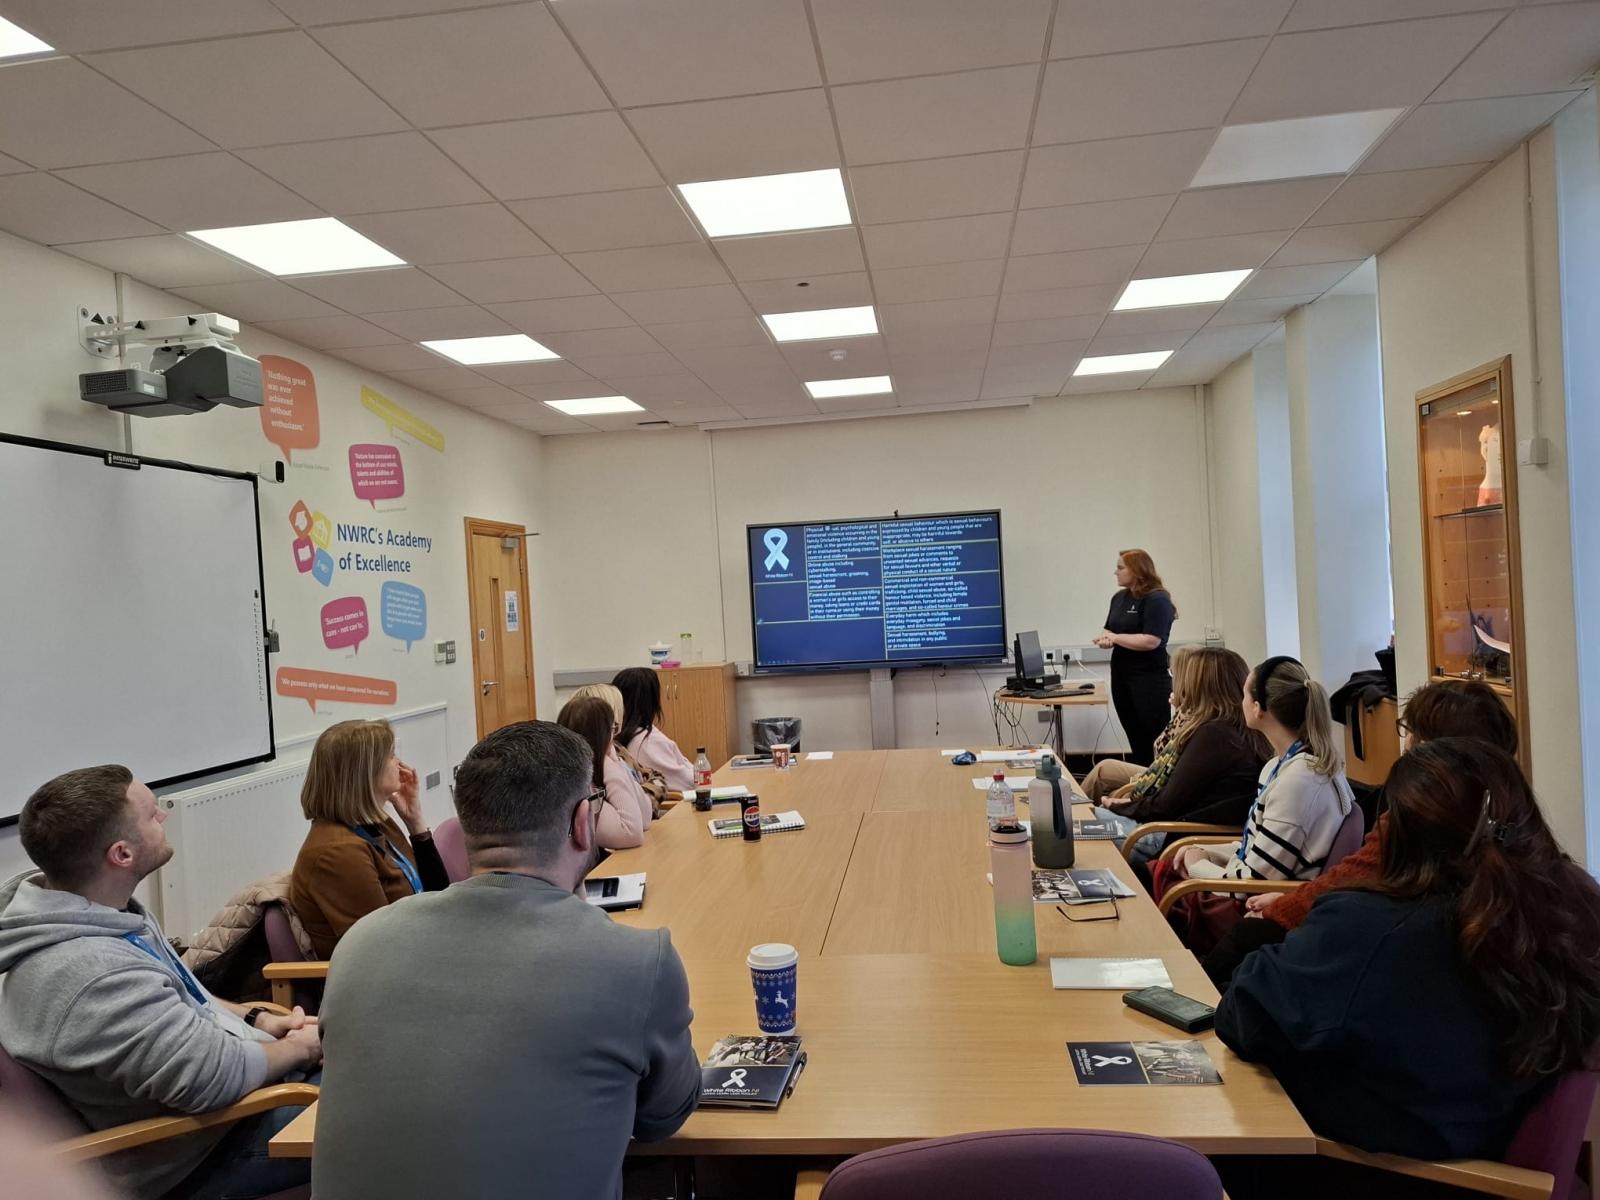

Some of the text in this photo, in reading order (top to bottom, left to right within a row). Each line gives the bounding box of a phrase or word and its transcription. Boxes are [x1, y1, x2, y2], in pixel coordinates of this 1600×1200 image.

[336, 523, 432, 553] NWRC's Academy
[339, 552, 412, 573] of Excellence
